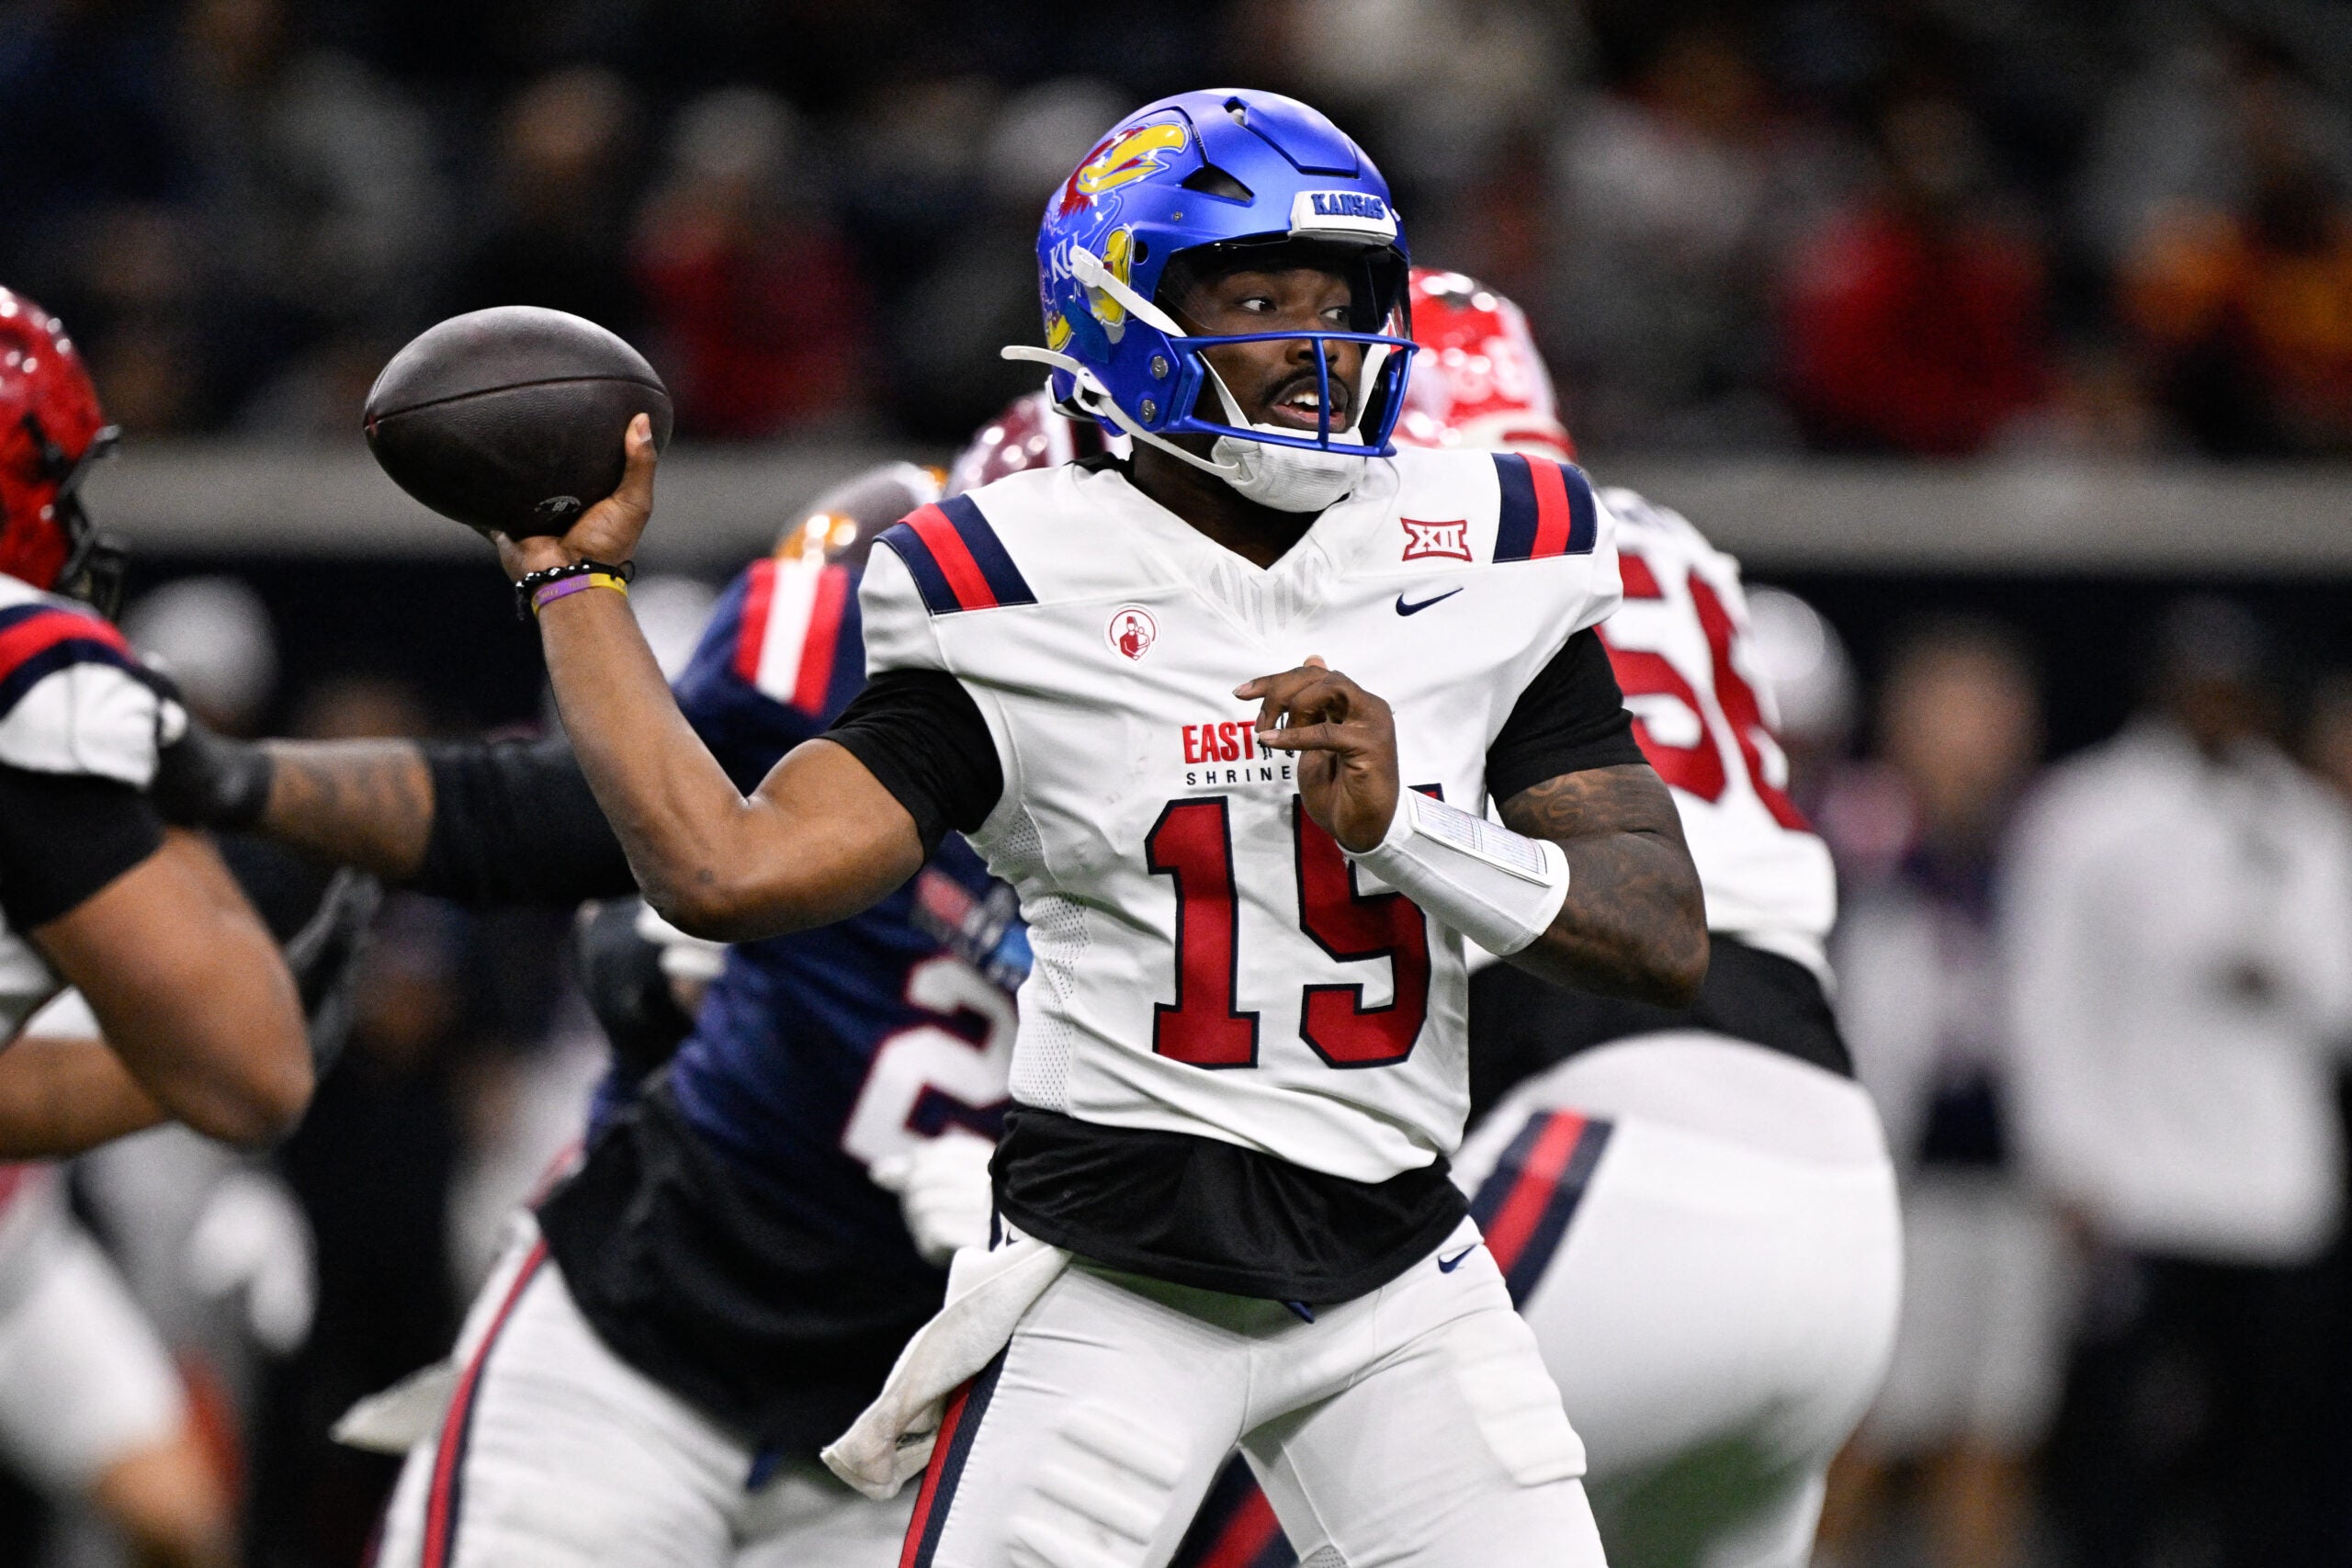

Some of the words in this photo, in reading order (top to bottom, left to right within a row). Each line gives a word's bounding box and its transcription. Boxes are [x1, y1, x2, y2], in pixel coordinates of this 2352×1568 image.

[1311, 193, 1385, 220] KANSAS
[1182, 721, 1256, 764] EAST
[1186, 765, 1291, 785] SHRINE
[1145, 784, 1445, 1069] 15
